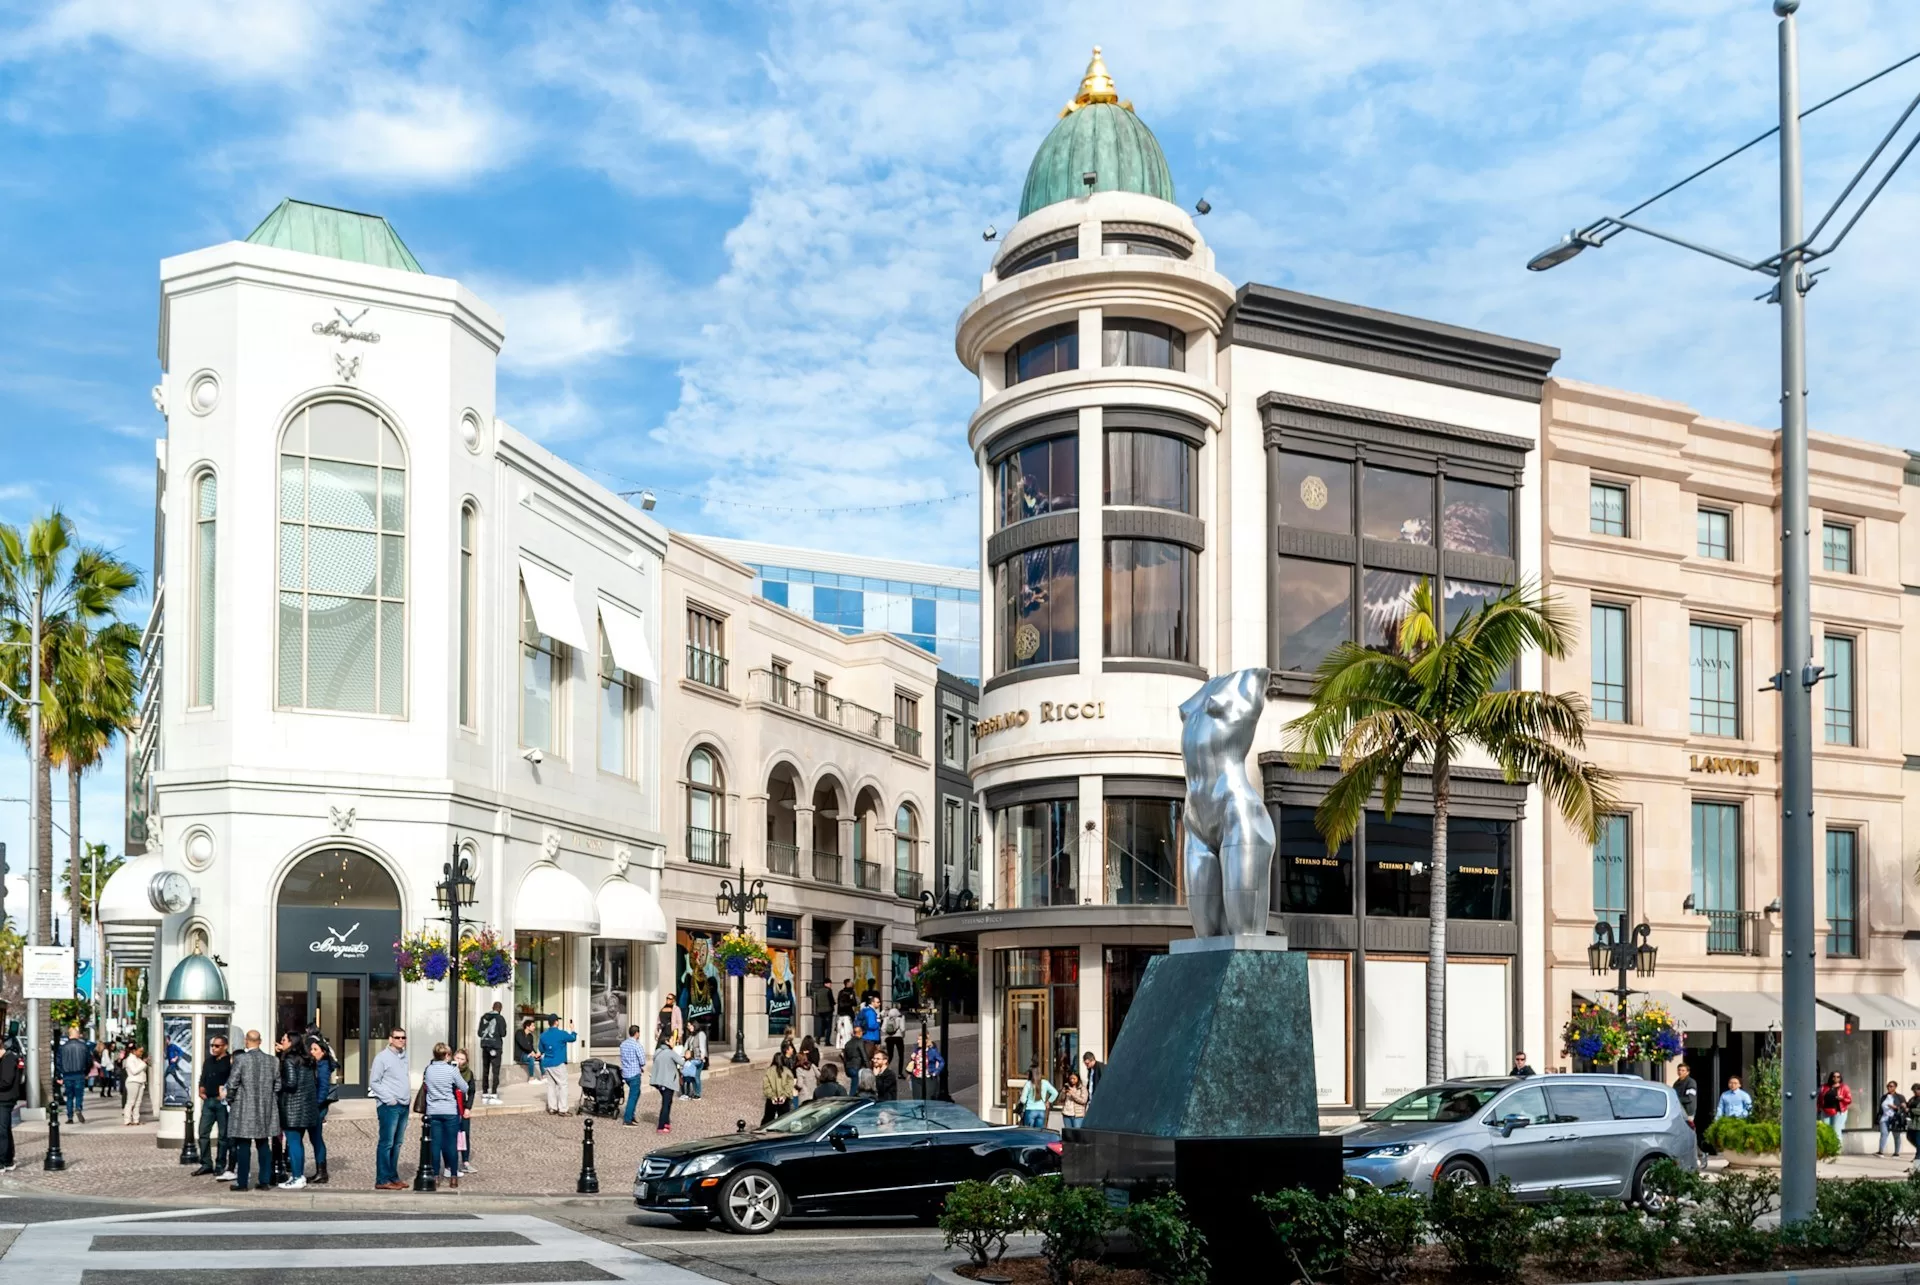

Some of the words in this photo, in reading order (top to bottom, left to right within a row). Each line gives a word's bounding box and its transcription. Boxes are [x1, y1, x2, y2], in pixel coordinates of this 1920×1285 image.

[312, 319, 380, 343] Breguet
[1040, 700, 1105, 723] RICCI
[1690, 754, 1759, 776] LANVIN
[1295, 857, 1321, 866] STEFANO
[1322, 858, 1338, 866] RICCI
[1379, 862, 1403, 870] STEFANO
[1459, 865, 1483, 874] STEFANO
[1484, 866, 1499, 875] RICCI
[309, 937, 369, 958] Breguet
[1884, 1019, 1917, 1028] LANVIN
